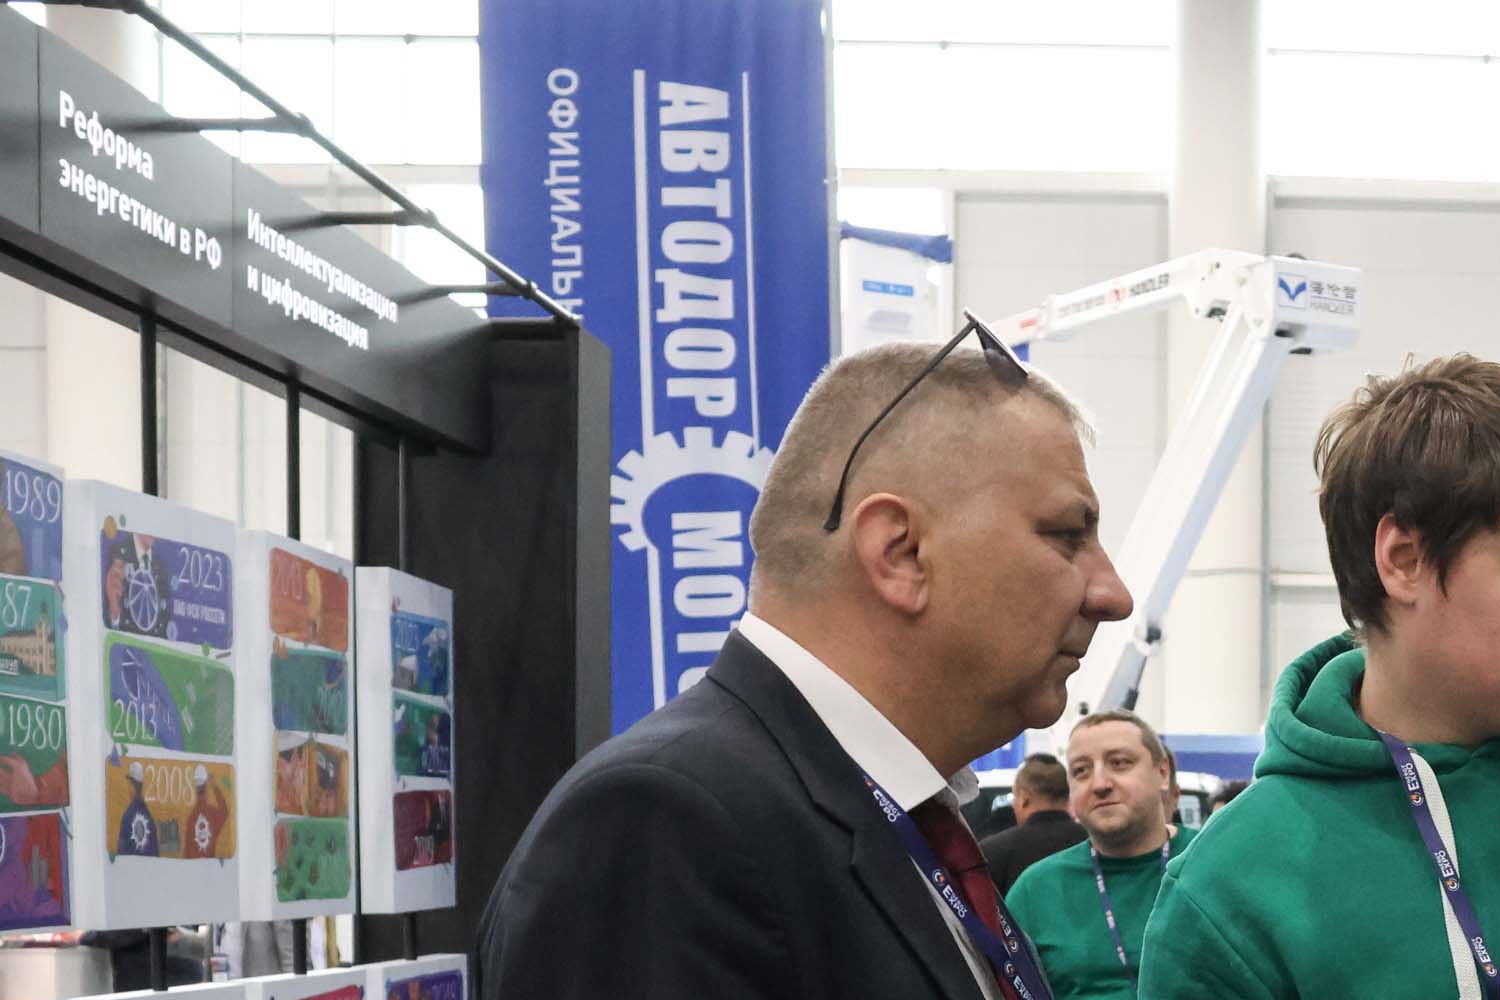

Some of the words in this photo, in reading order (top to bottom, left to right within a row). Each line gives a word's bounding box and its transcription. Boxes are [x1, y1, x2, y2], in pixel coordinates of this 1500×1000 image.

[60, 91, 154, 181] Реформа
[58, 159, 176, 247] энергетики
[180, 232, 191, 255] в
[195, 228, 222, 270] РФ
[248, 208, 398, 323] Интеллектуализация
[655, 81, 738, 418] АВТОДОР
[248, 265, 258, 292] и
[262, 273, 369, 350] цифровизация
[6, 470, 60, 523] 1989
[179, 547, 222, 592] 2023
[0, 582, 32, 628] 87
[8, 703, 62, 750] 1980
[113, 698, 158, 740] 2013
